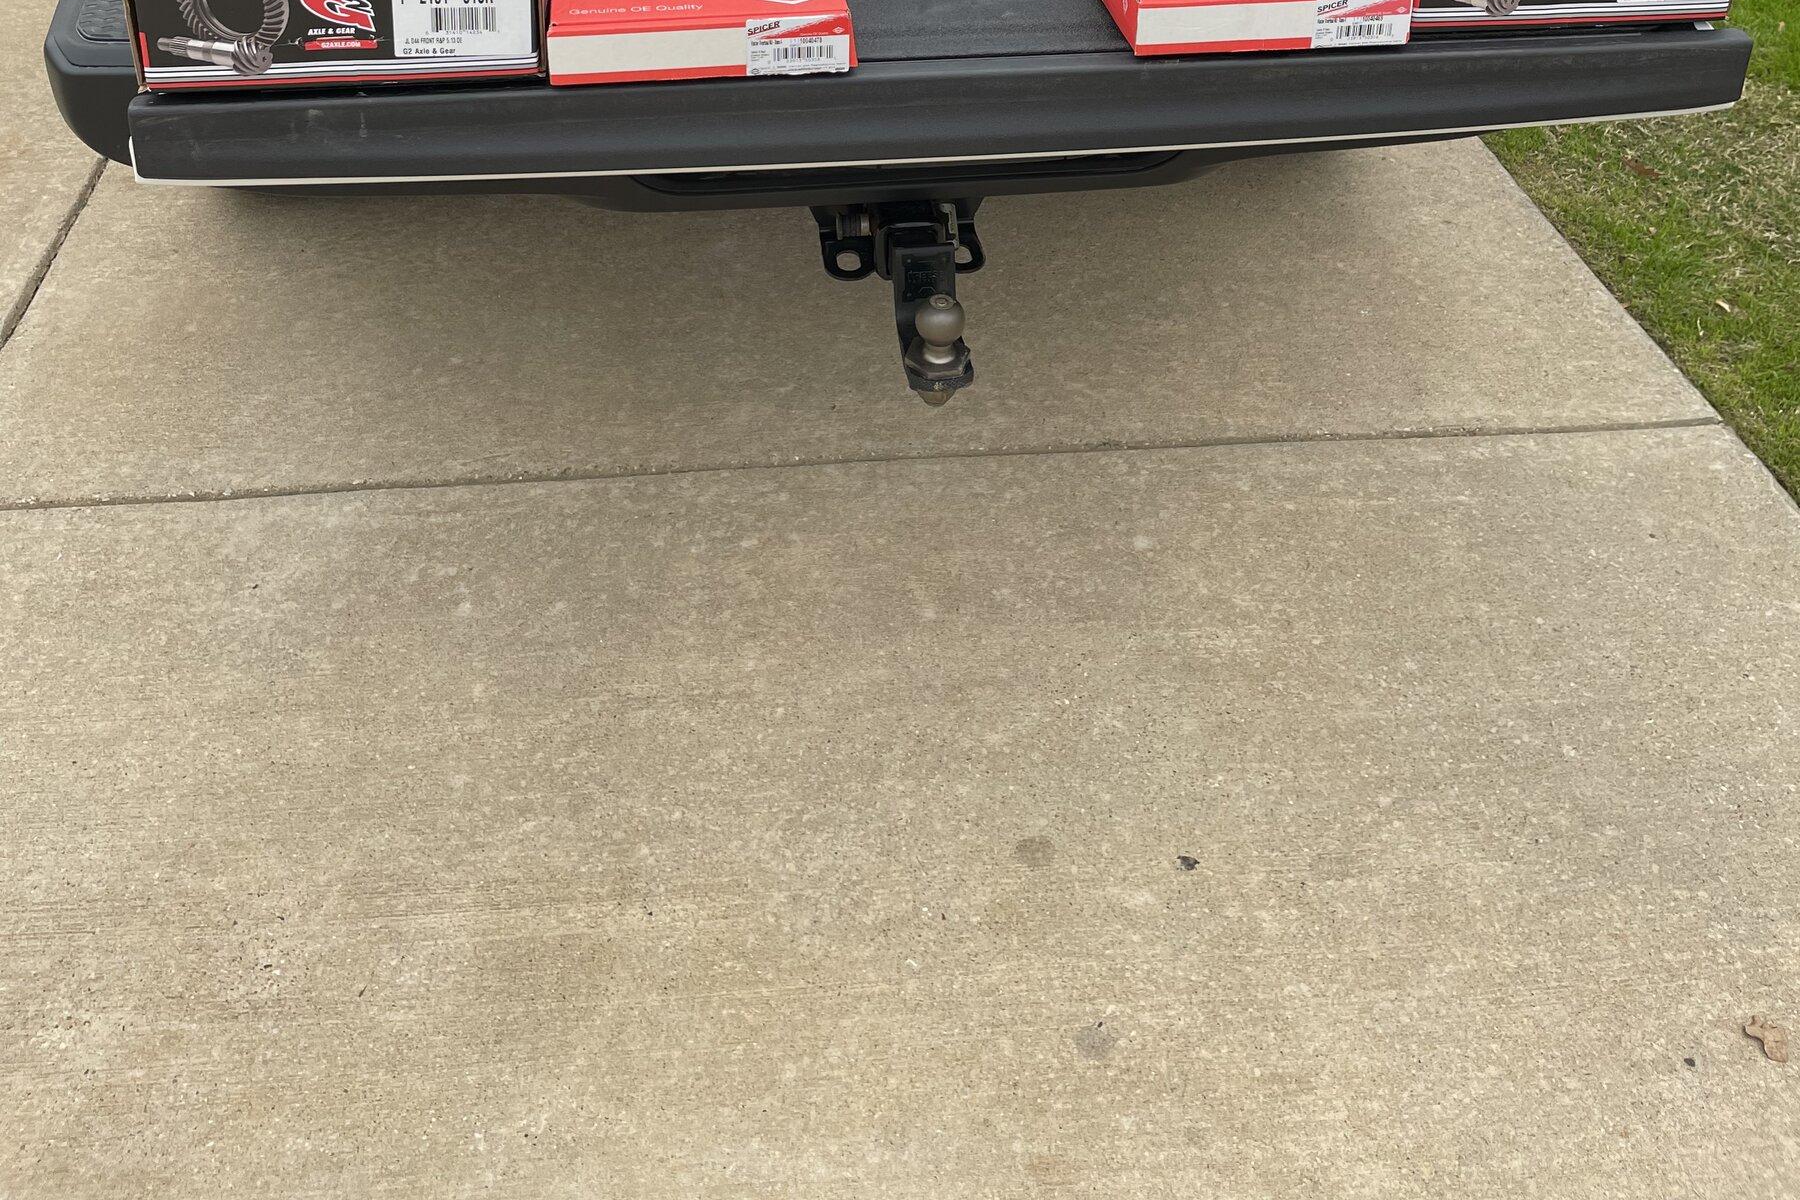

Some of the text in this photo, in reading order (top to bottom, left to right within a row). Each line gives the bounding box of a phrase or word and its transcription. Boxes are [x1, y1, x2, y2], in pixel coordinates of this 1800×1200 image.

[568, 3, 704, 16] Genuine OE Quality
[1317, 0, 1349, 13] SPICER
[307, 28, 326, 36] AXLE
[747, 21, 780, 36] SPICER
[320, 41, 361, 49] G2AXLE.COM
